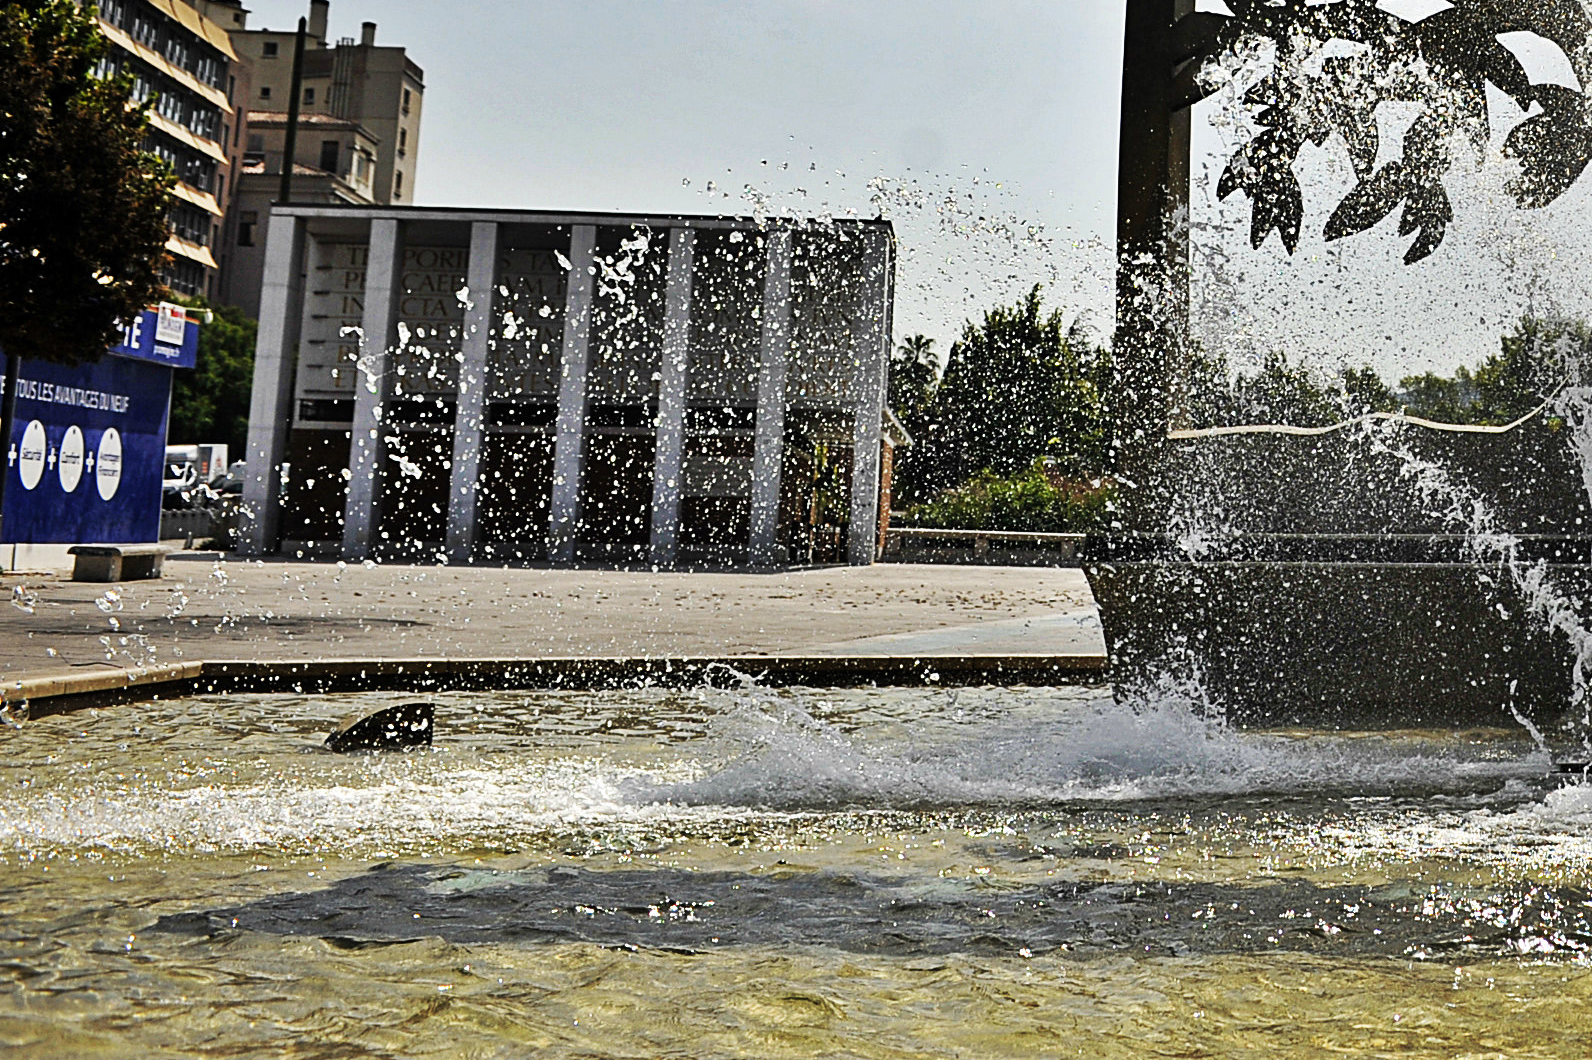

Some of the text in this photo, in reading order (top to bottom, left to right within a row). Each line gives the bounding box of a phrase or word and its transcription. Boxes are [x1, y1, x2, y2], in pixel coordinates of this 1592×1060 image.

[37, 382, 54, 402] LES
[54, 385, 99, 409] AVANTAGES
[99, 392, 110, 411] DU
[110, 394, 130, 413] NEUF
